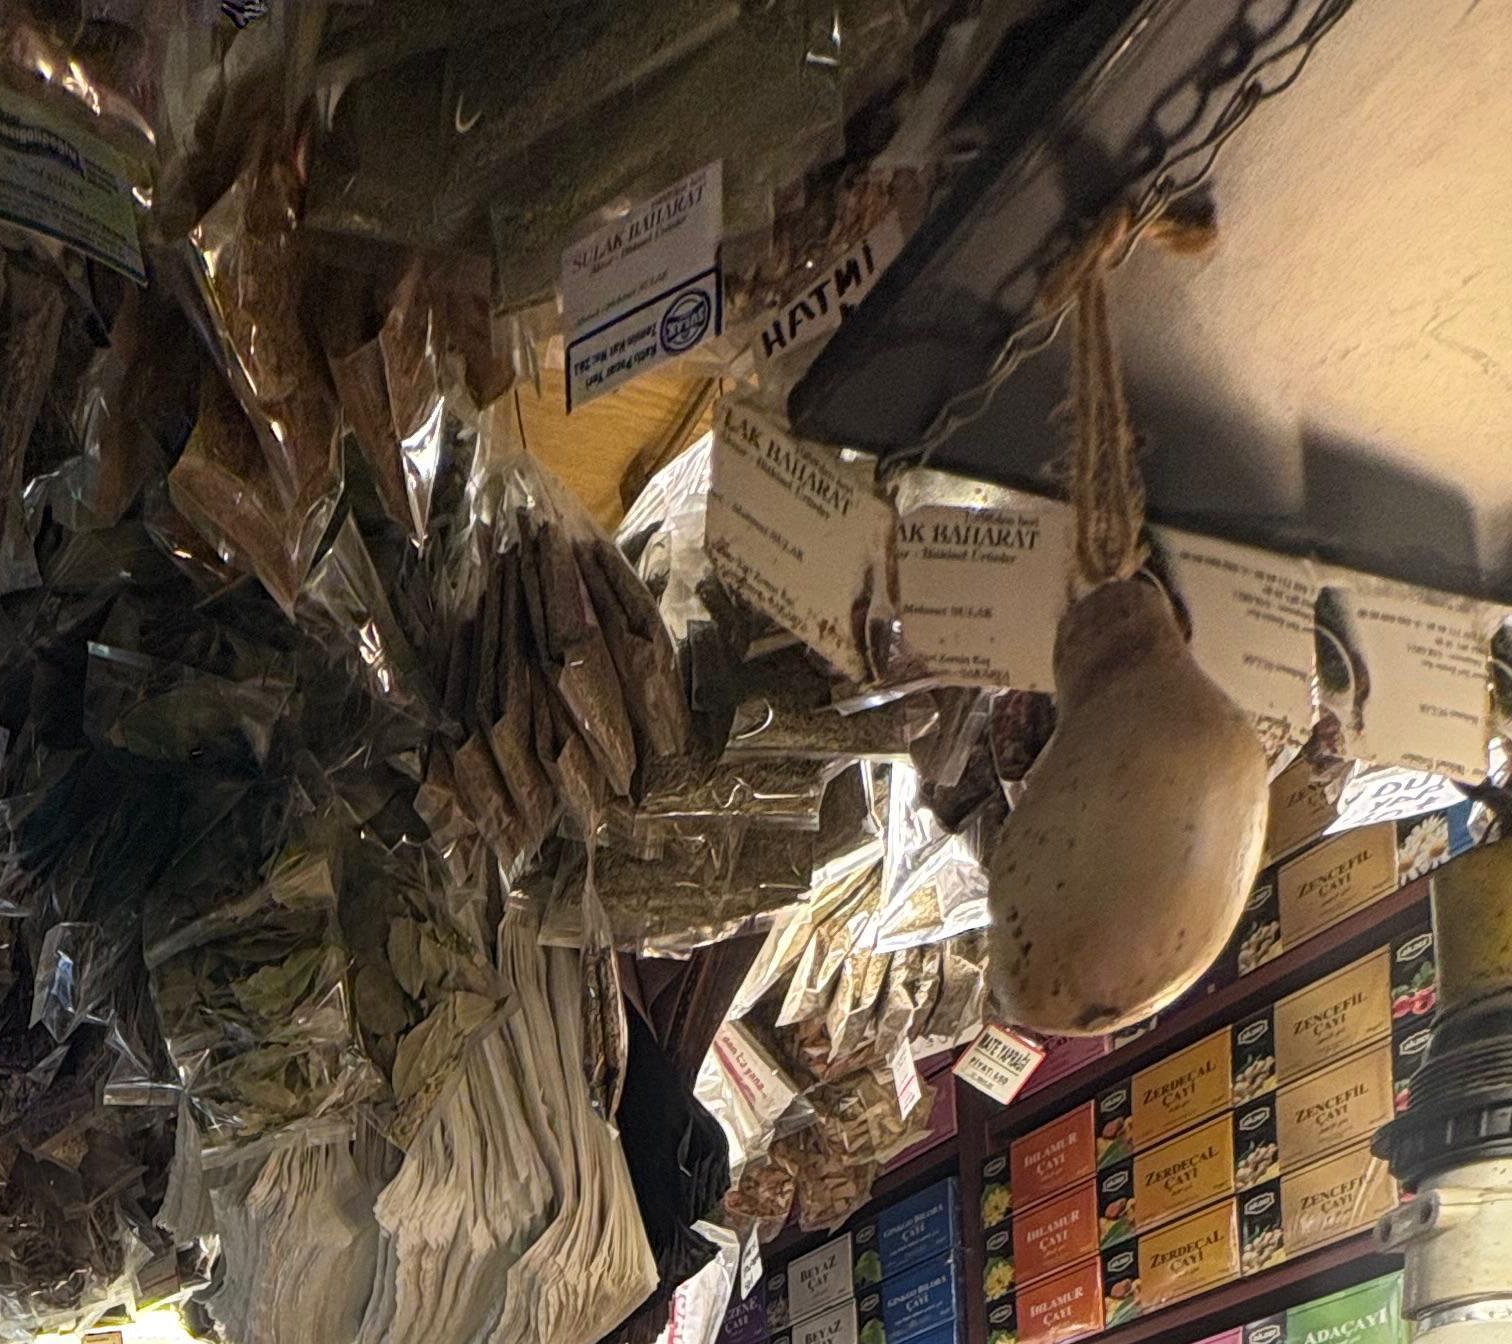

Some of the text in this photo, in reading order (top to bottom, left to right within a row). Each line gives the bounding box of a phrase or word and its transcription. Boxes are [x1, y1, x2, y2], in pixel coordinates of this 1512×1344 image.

[572, 232, 622, 274] SULAK
[628, 186, 704, 243] BAHARAT
[766, 440, 854, 517] BAHARAT
[933, 525, 1040, 550] BAHARAT
[1297, 850, 1372, 900] ZENCEFİL
[1319, 875, 1352, 897] ÇAYI
[1293, 992, 1368, 1034] ZENCEFİL
[1313, 1013, 1346, 1036] ÇAYI
[1143, 1060, 1216, 1104] ZERDEÇAL
[1162, 1083, 1196, 1107] ÇAYI
[1295, 1084, 1368, 1124] ZENCEFİL
[1315, 1104, 1349, 1125] ÇAYI
[1037, 1154, 1065, 1175] ÇAYI
[1145, 1146, 1218, 1186] ZERDEÇAL
[1164, 1169, 1198, 1192] ÇAYI
[1039, 1230, 1068, 1251] ÇAYI
[1150, 1230, 1224, 1268] ZERDEÇAL
[800, 1254, 838, 1283] BEYAZ
[1170, 1251, 1204, 1273] ÇAYI
[808, 1275, 829, 1292] ÇAY
[1043, 1306, 1071, 1326] ÇAYI
